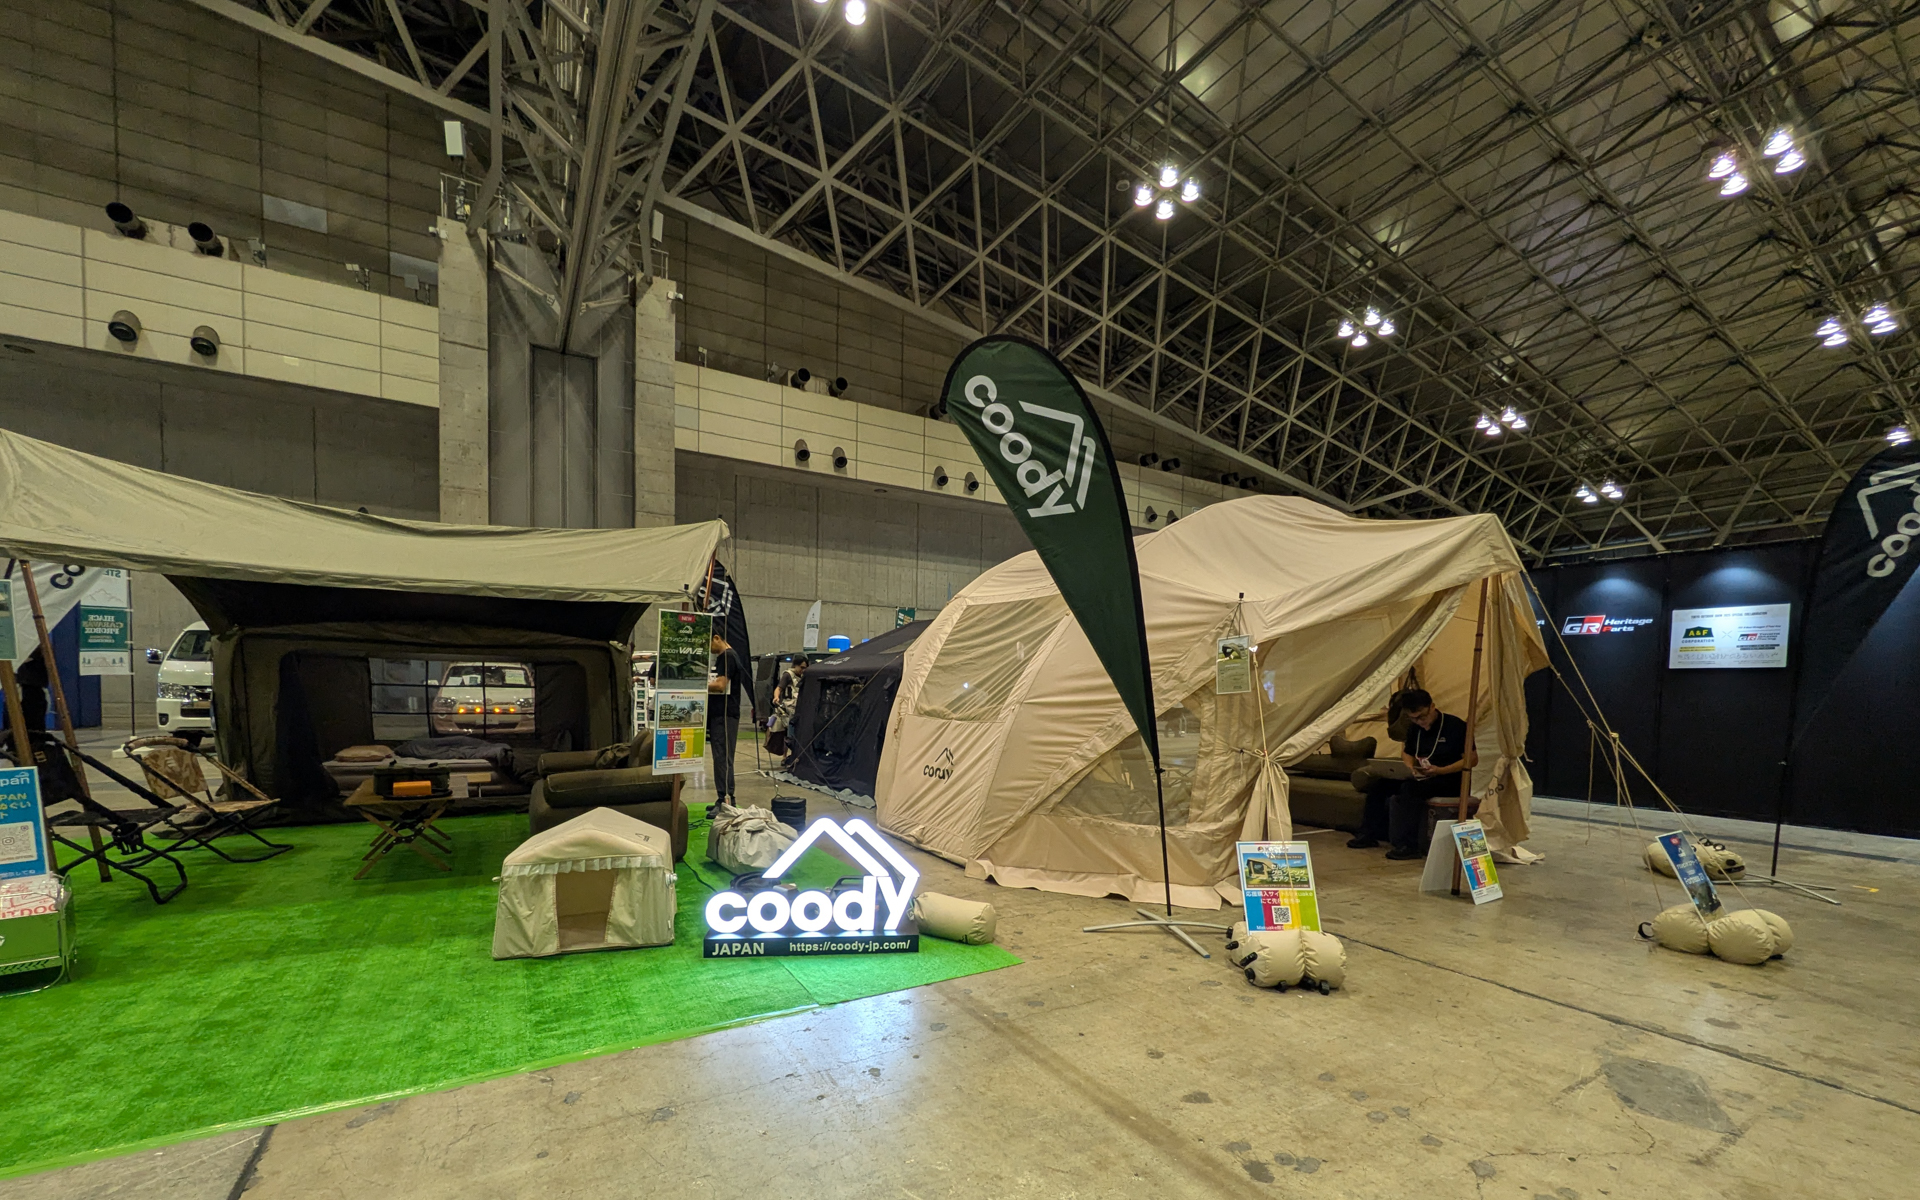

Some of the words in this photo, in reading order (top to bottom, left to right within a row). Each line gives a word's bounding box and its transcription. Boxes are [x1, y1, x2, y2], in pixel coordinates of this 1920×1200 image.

[964, 374, 1076, 518] coody
[1565, 622, 1601, 634] GR
[1604, 618, 1654, 626] Heritage
[1602, 625, 1635, 633] Parts
[705, 876, 919, 933] coody
[712, 942, 765, 955] JAPAN
[789, 940, 911, 953] https://coody-jp.com/
